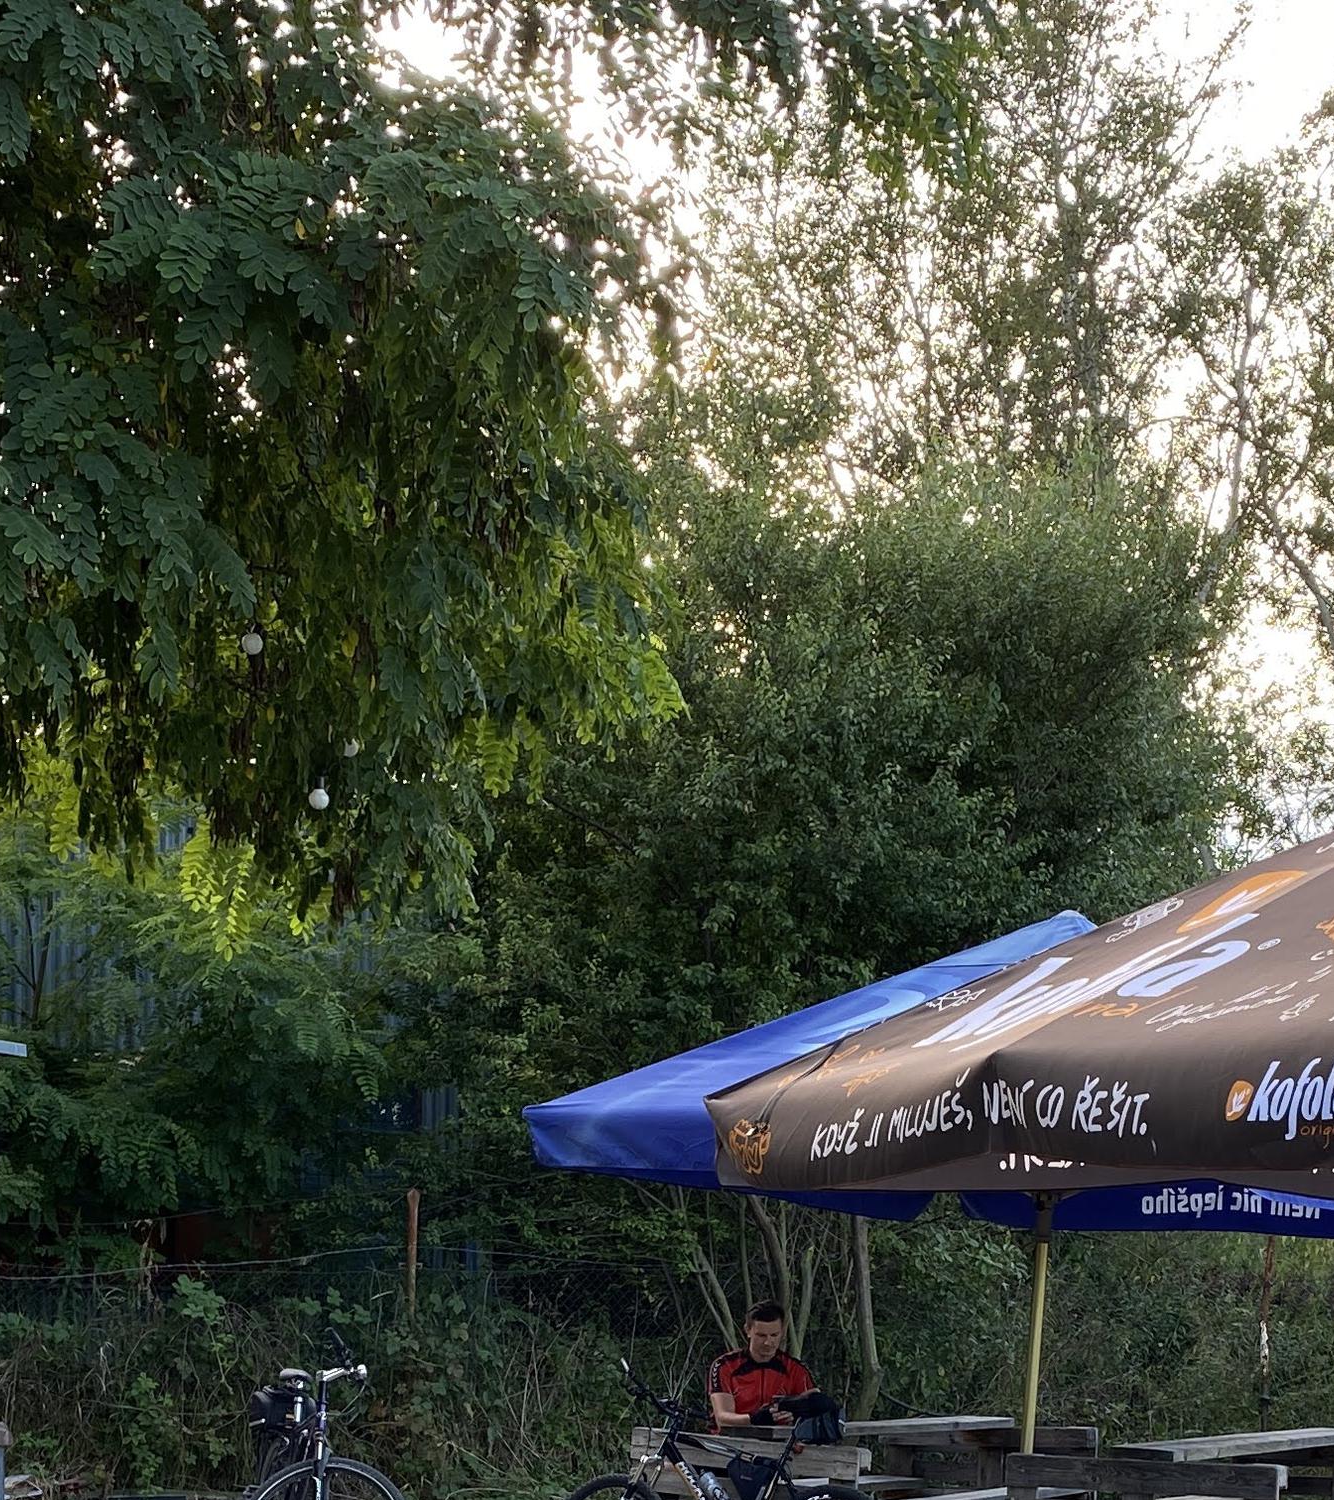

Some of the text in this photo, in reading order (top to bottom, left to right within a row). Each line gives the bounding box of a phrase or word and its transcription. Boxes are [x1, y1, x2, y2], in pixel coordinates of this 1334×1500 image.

[810, 1067, 1150, 1161] KDYŽ JI MILUJEŠ, NENÍ CO ŘEŠIT.
